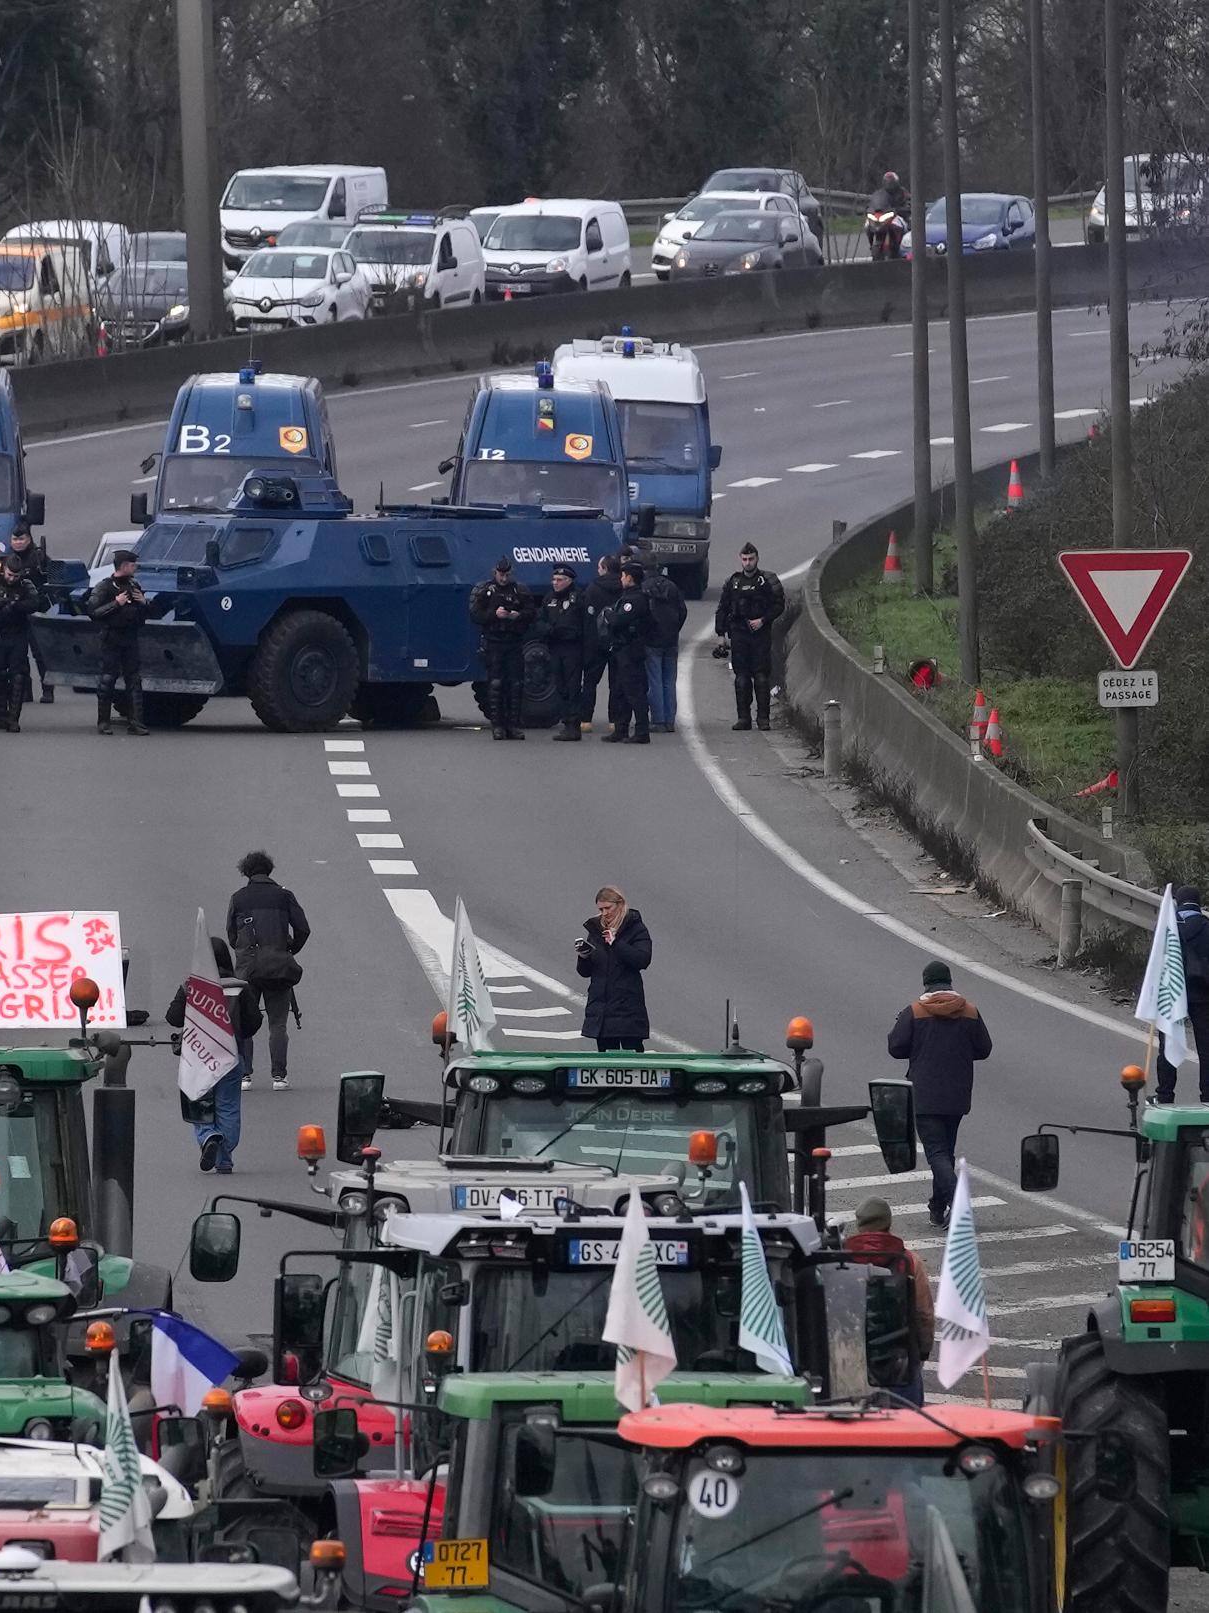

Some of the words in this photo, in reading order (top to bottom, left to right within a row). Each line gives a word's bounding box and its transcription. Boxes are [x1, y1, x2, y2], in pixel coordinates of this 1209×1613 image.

[180, 424, 232, 453] B2
[512, 546, 591, 563] GENDARMERIE
[1102, 677, 1136, 688] CÉDEZ
[1142, 677, 1154, 686] LE
[1105, 690, 1152, 700] PASSAGE
[616, 1107, 675, 1122] DEERE
[1128, 1242, 1175, 1258] 06254
[699, 1477, 728, 1508] 40
[438, 1542, 482, 1562] 0727
